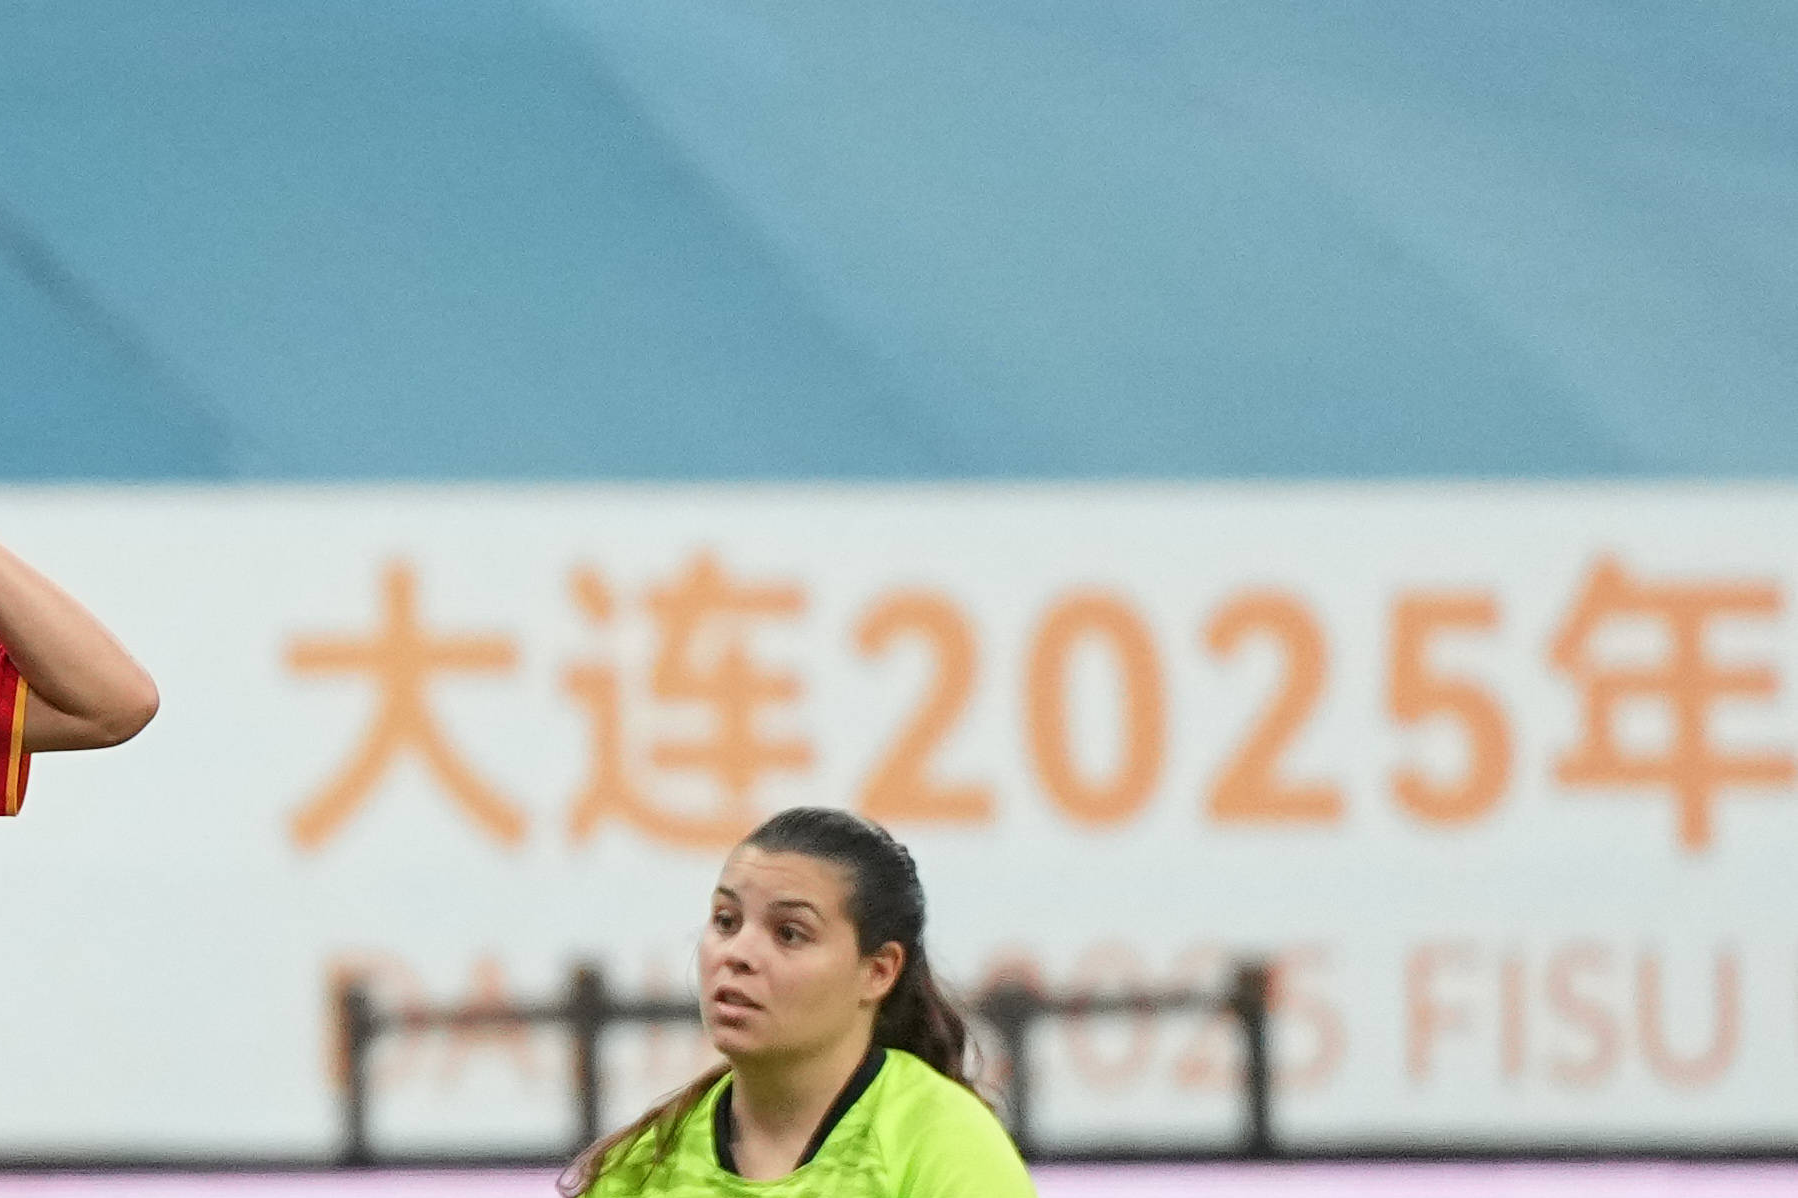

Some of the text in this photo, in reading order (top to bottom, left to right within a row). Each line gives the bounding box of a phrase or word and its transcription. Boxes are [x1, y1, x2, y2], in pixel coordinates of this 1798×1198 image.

[282, 550, 1796, 853] 大连2025年
[1404, 942, 1740, 1088] FISU
